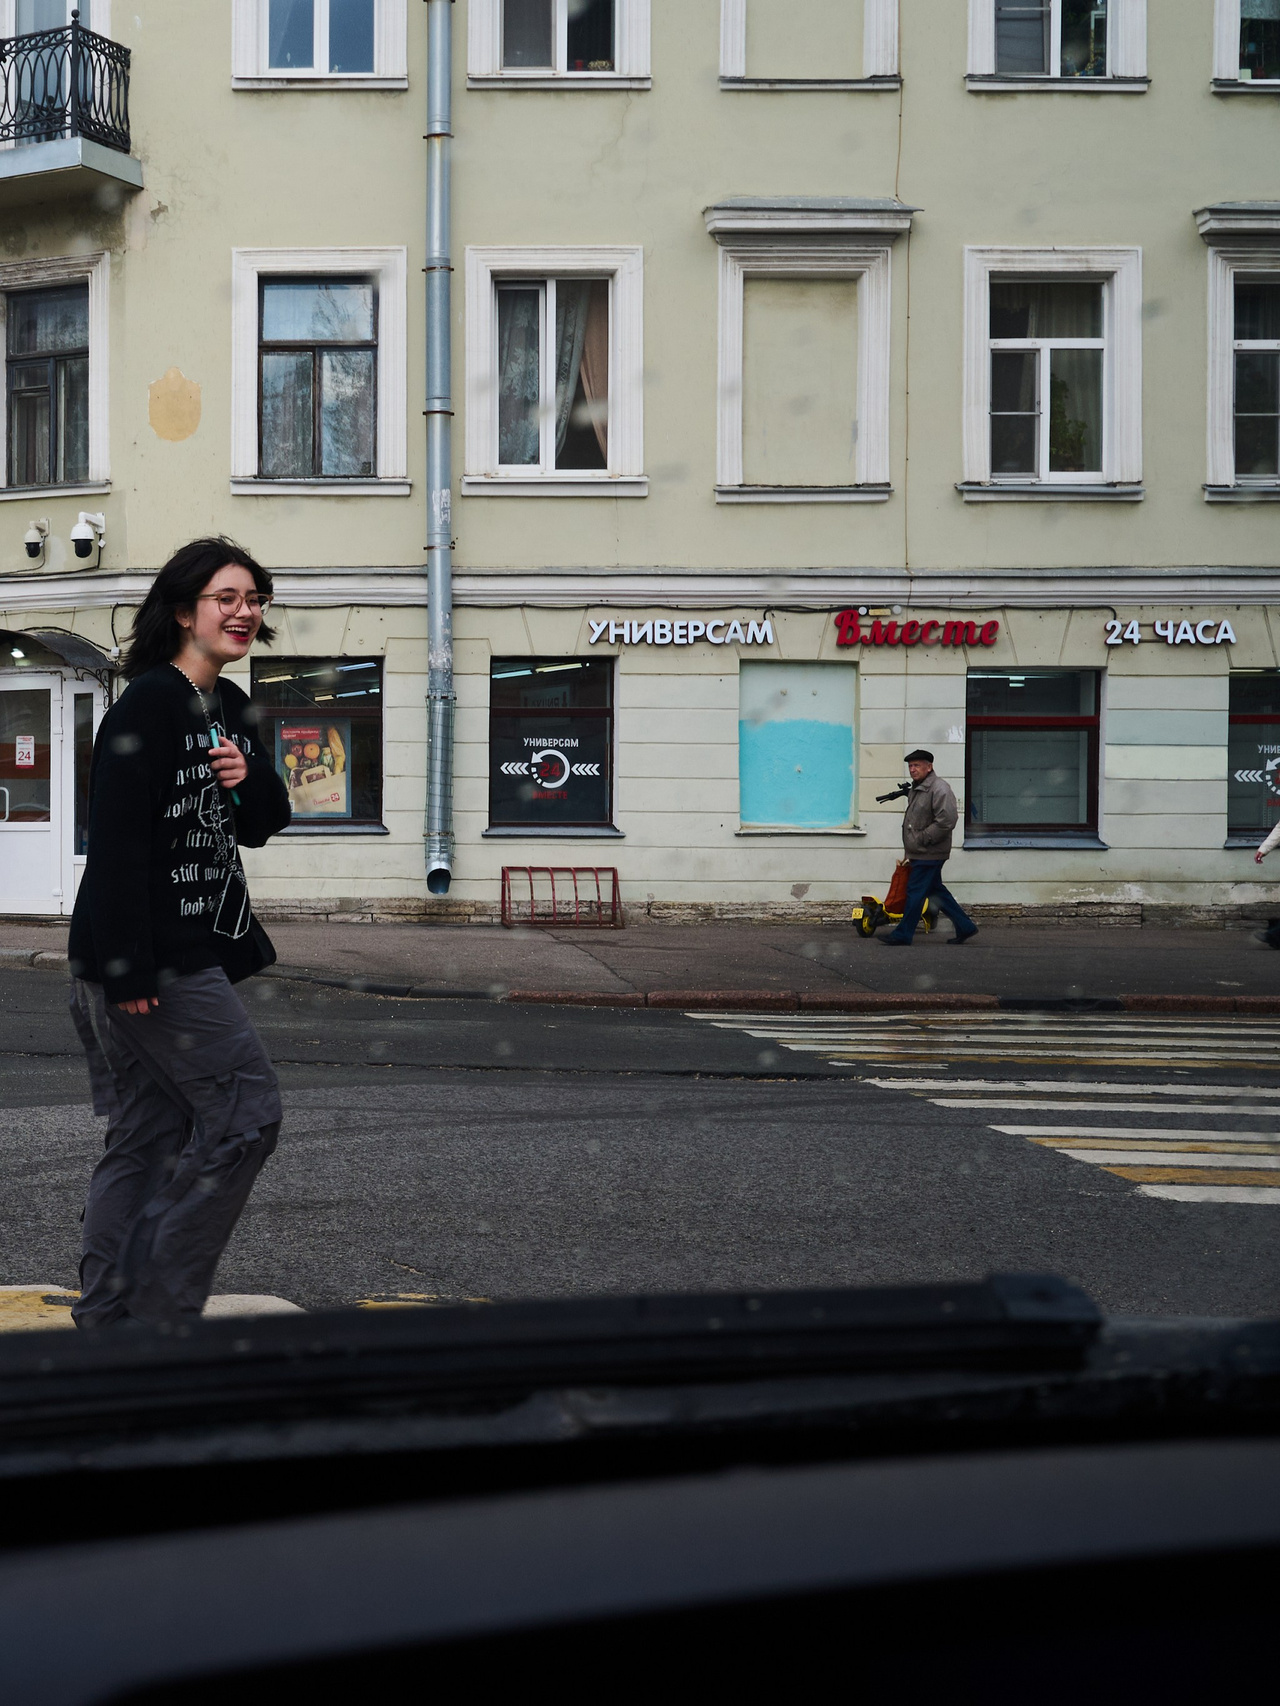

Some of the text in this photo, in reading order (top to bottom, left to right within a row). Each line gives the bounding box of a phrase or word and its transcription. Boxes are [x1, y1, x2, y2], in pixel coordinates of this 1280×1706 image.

[588, 609, 1237, 646] УНИВЕРСАМ Вместе 24 ЧАСА
[523, 737, 579, 748] УНИВЕРСАМ
[18, 750, 31, 761] 24
[540, 762, 560, 777] 24
[532, 790, 568, 800] ВМЕСТЕ
[171, 863, 199, 884] still
